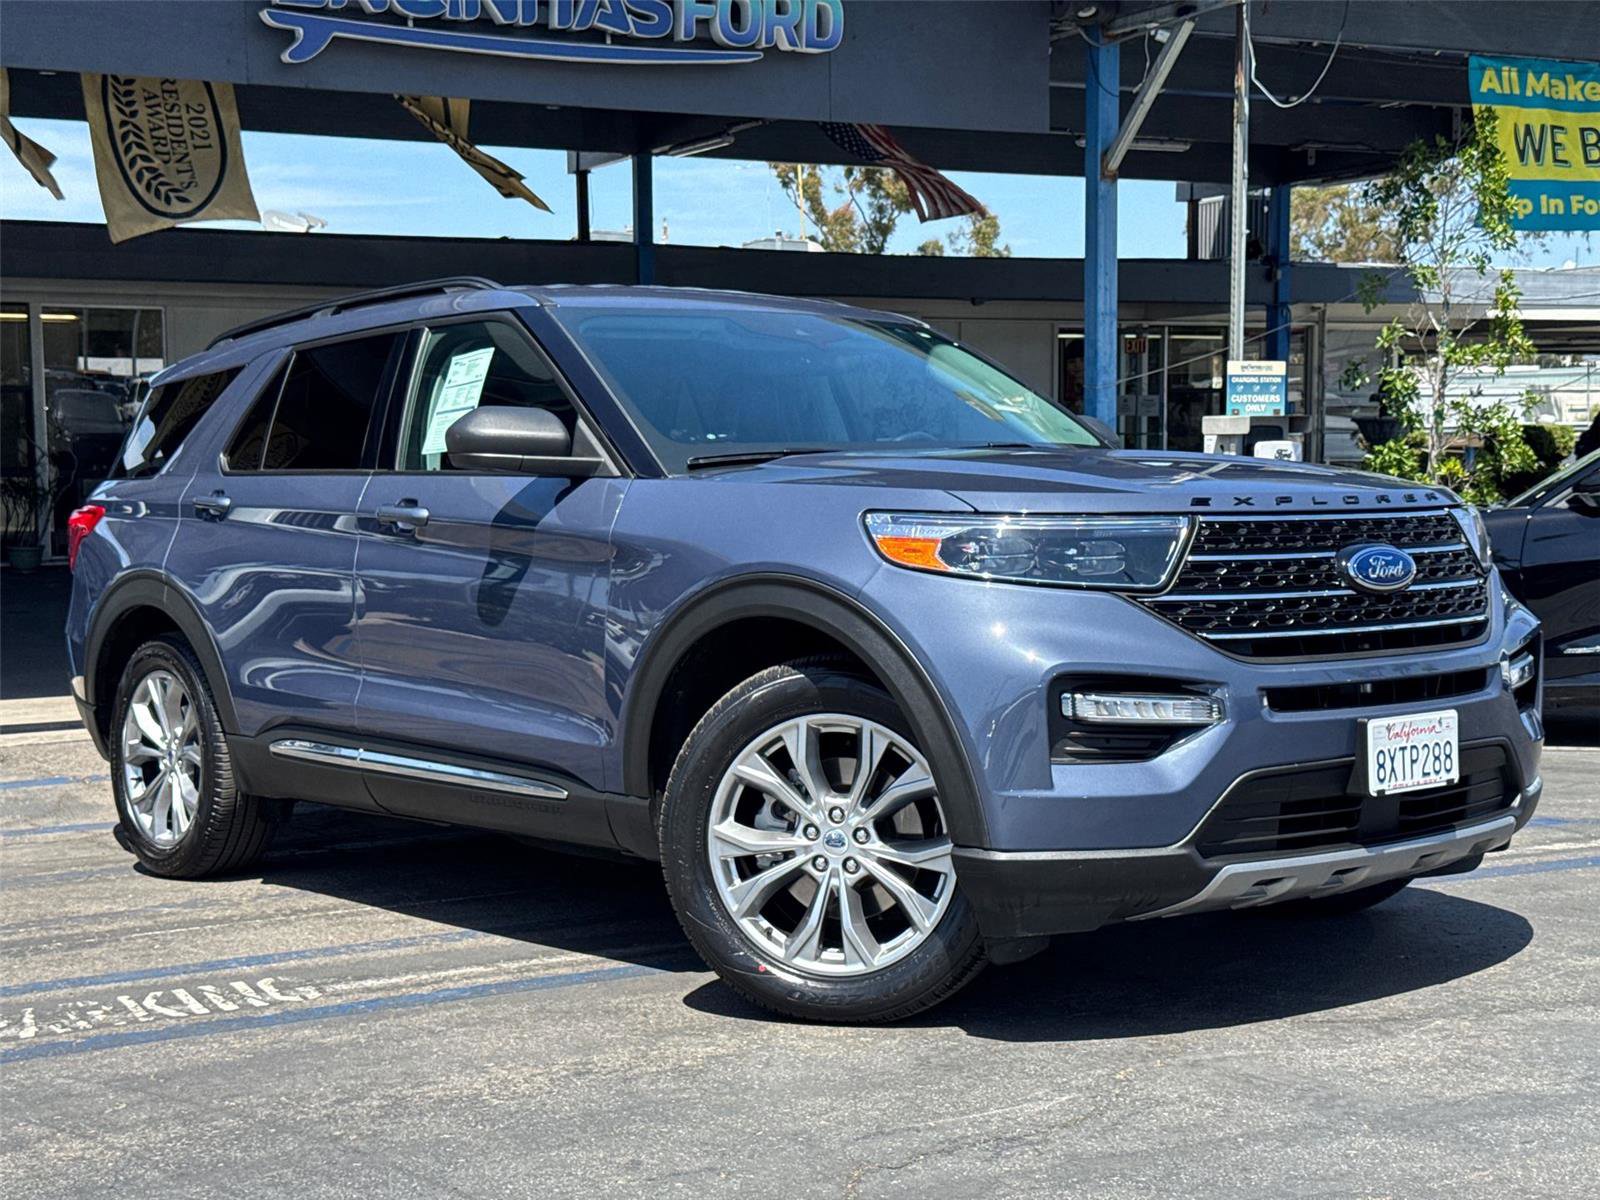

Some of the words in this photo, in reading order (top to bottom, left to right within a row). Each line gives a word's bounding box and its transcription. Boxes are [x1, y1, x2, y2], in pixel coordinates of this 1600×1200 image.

[674, 0, 844, 53] FORD
[1480, 66, 1520, 95] All
[142, 88, 171, 166] AWARD
[185, 103, 212, 151] 2021
[1514, 123, 1572, 167] WE
[1540, 194, 1564, 215] In
[1570, 194, 1600, 215] Fo
[1126, 338, 1146, 353] EXIT
[1231, 394, 1281, 403] CUSTOMERS
[1245, 404, 1266, 412] ONLY
[1190, 492, 1440, 507] EXPLORER
[1368, 555, 1404, 578] Ford
[1386, 719, 1441, 743] California
[1376, 740, 1452, 783] 8XTP288
